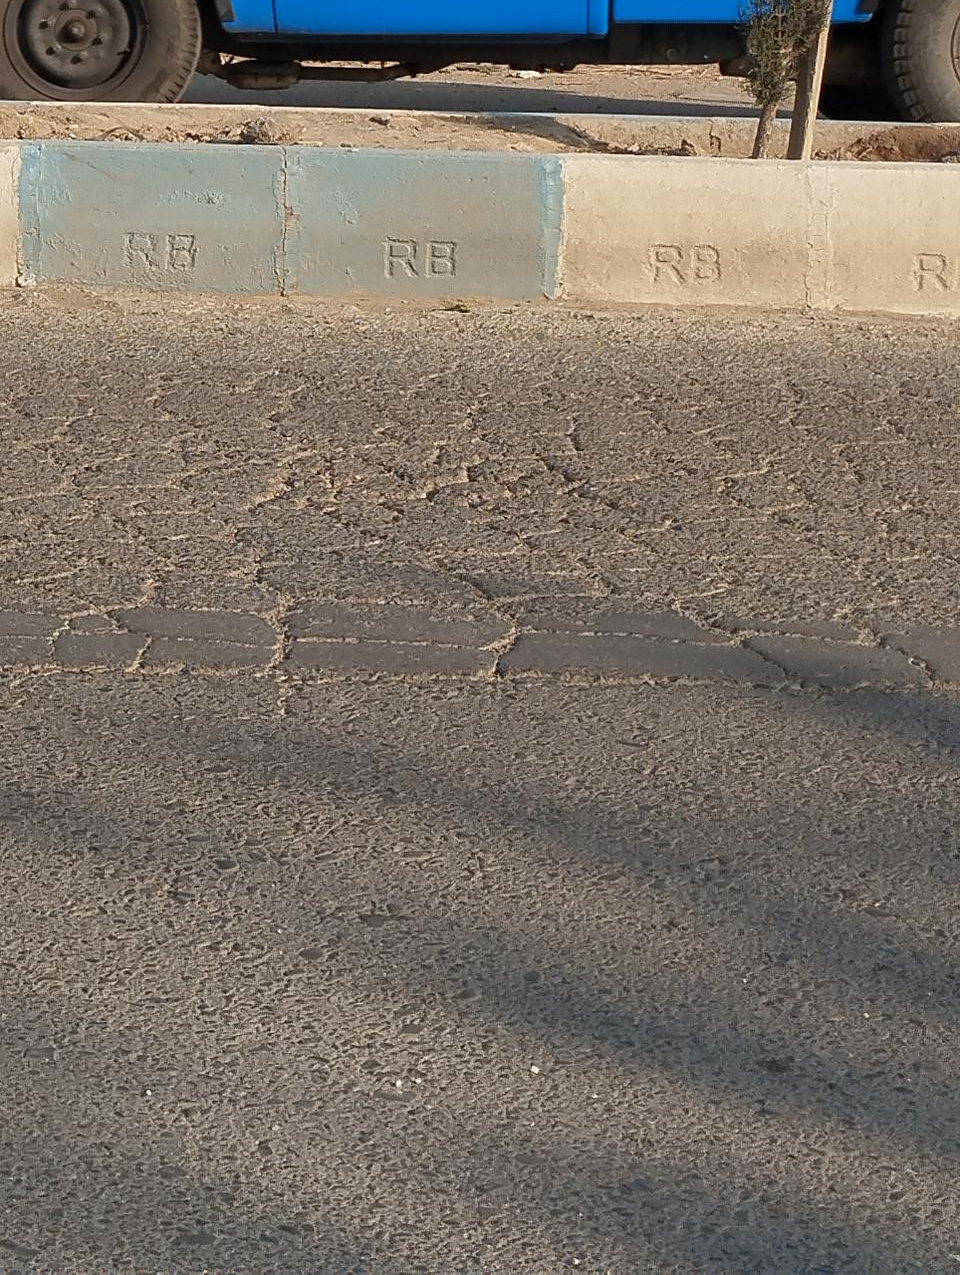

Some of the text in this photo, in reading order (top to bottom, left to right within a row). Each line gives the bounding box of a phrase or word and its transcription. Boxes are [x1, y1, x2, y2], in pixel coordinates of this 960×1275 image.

[124, 231, 196, 272] RB
[382, 235, 457, 278] RB
[648, 243, 722, 286] RB
